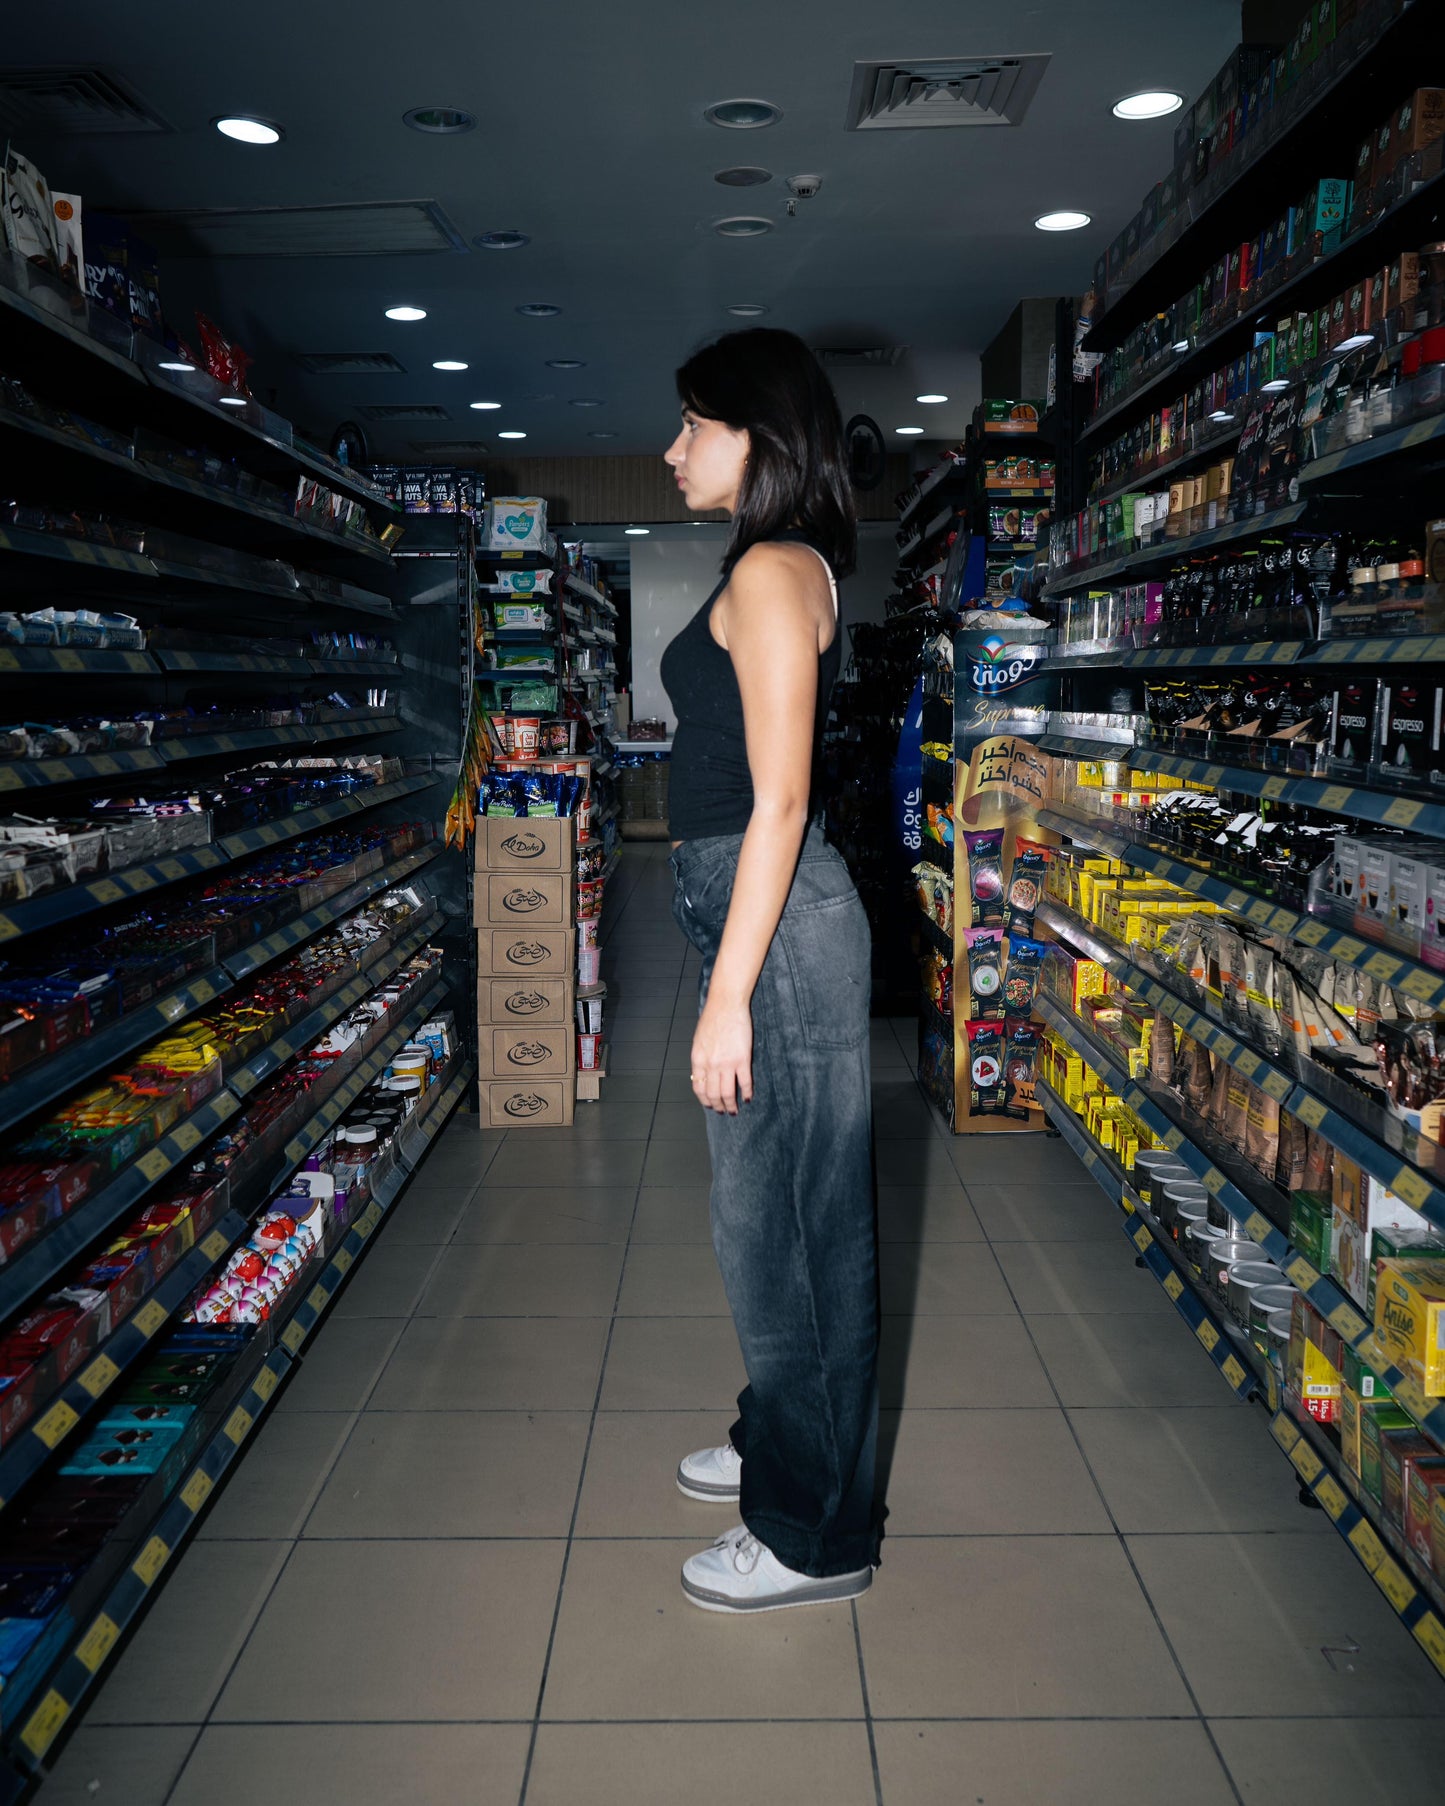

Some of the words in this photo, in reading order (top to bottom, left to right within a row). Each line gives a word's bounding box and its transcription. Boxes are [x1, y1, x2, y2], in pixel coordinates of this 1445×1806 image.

[1340, 714, 1367, 728] espresso
[1392, 718, 1424, 733] espresso
[980, 738, 1016, 764] أكبر
[1384, 1300, 1414, 1334] Anise
